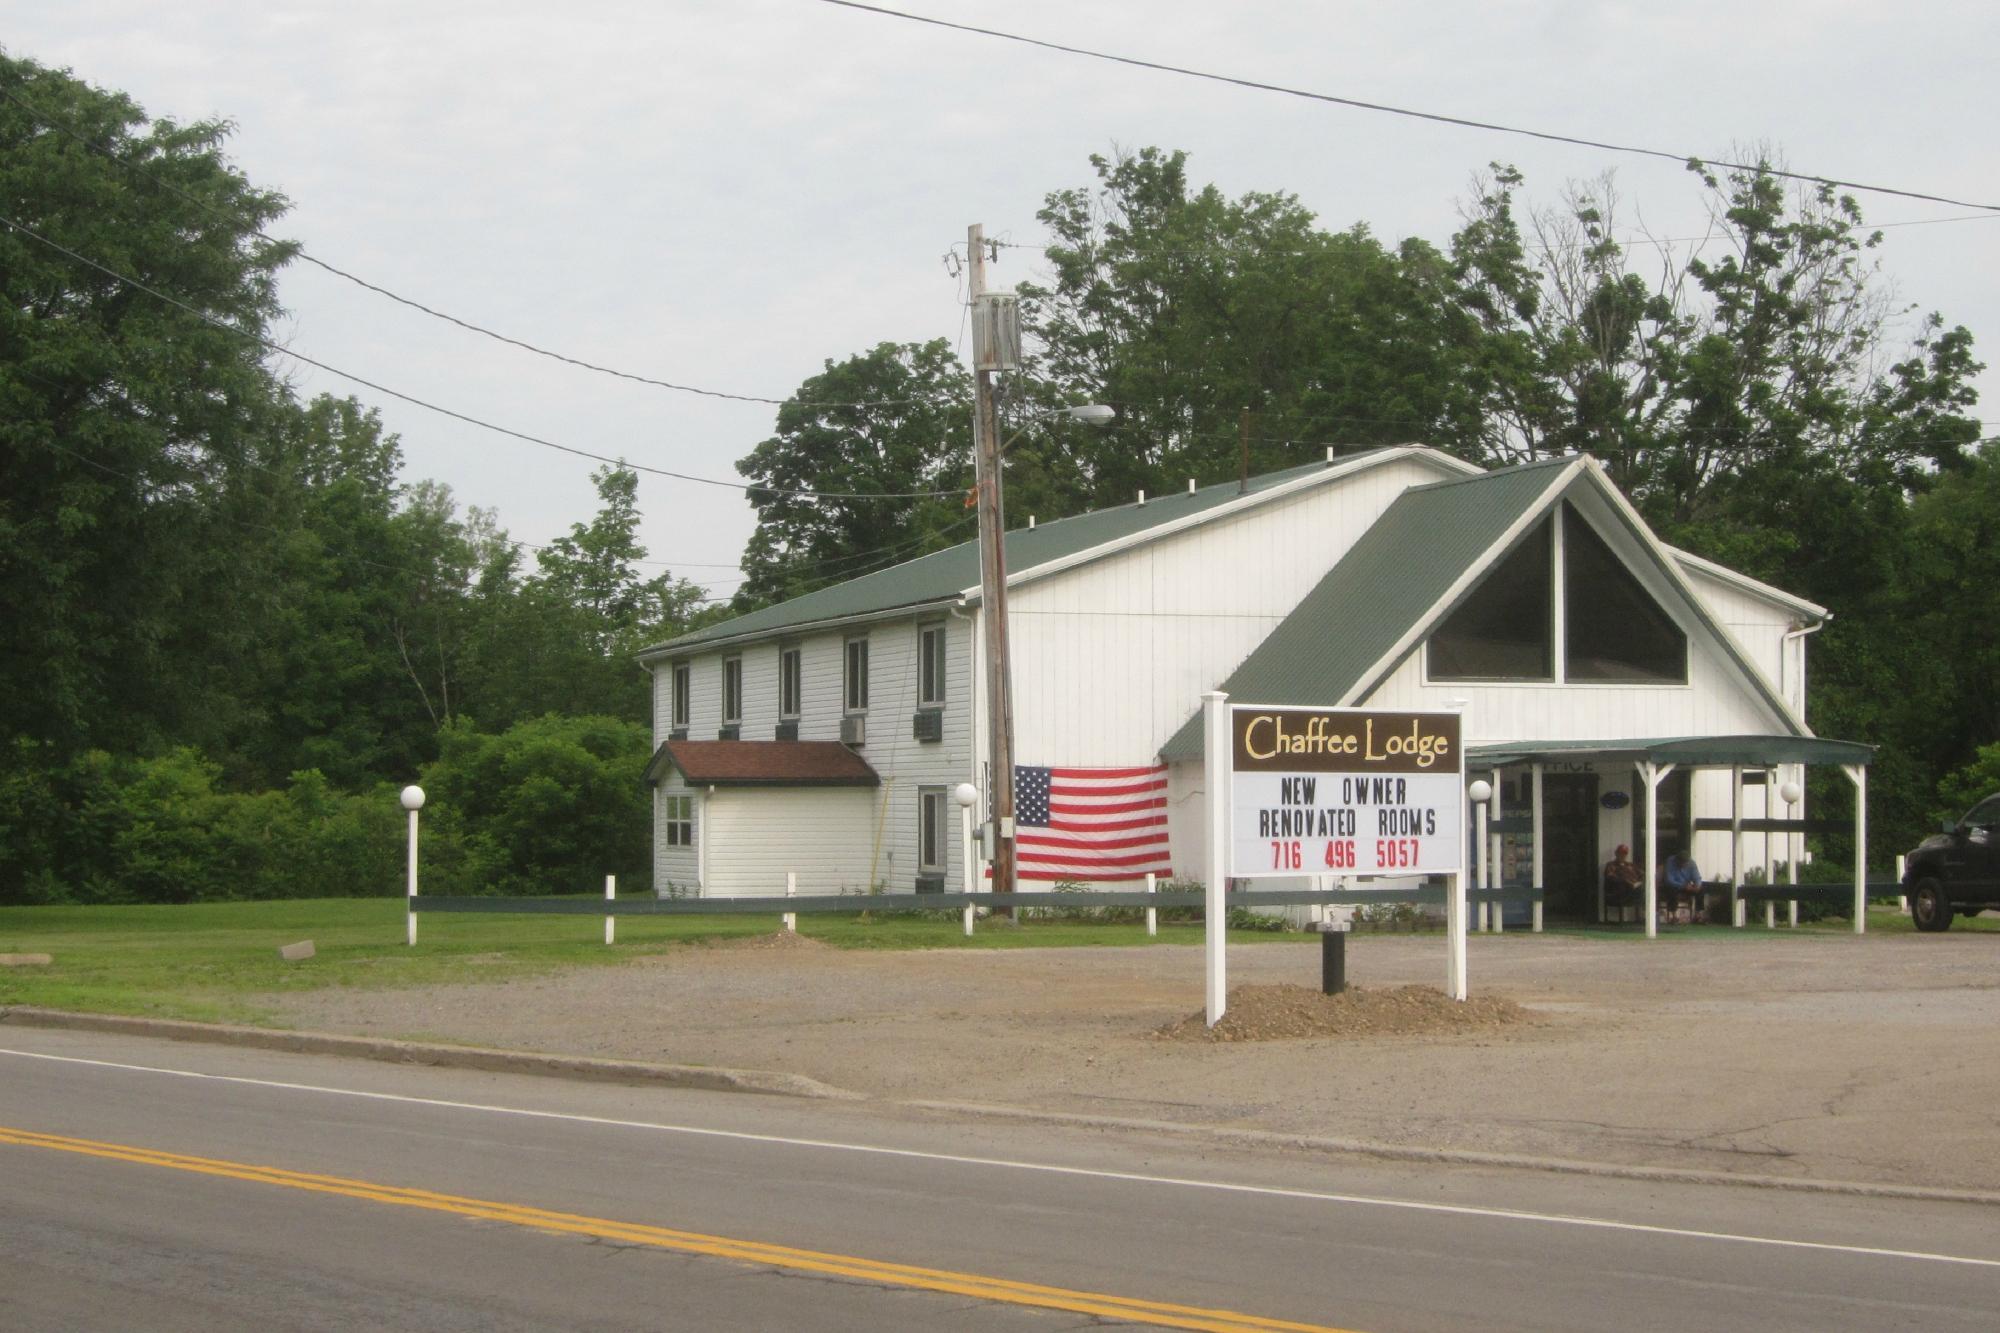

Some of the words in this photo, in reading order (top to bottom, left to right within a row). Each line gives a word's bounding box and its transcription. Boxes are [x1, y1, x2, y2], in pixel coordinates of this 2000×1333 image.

[1245, 715, 1358, 760] Chaffee
[1365, 718, 1449, 767] Lodge
[1281, 777, 1316, 805] NEW
[1342, 777, 1406, 805] OWNER
[1259, 809, 1356, 838] RENOVATED
[1378, 808, 1436, 836] ROOMS
[1271, 841, 1301, 869] 716
[1324, 840, 1356, 868] 496
[1376, 839, 1419, 867] 5057
